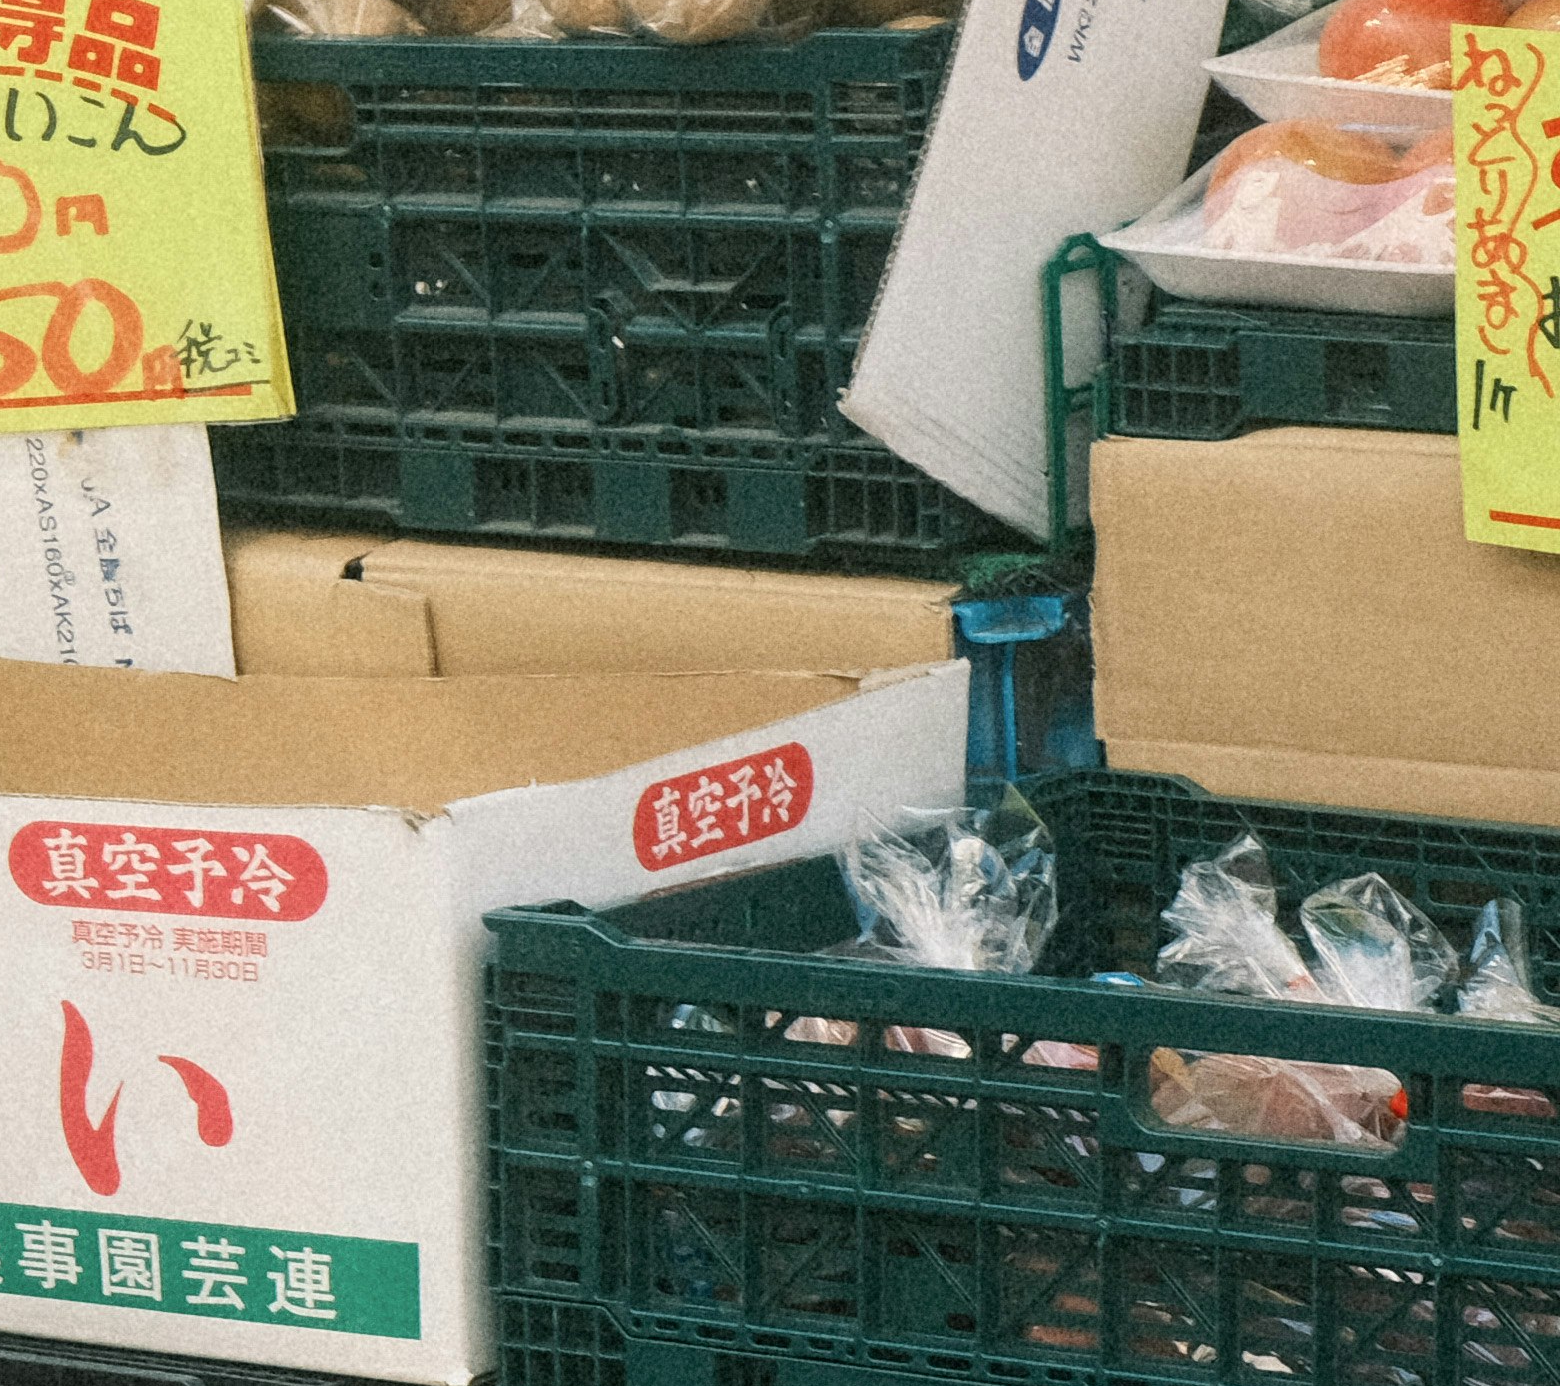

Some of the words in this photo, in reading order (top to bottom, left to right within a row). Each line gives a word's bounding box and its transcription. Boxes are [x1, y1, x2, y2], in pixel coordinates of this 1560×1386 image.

[648, 757, 808, 857] 真空予冷
[39, 829, 295, 919] 真空予冷
[68, 916, 167, 957] 真空予冷
[170, 924, 270, 963] 実施期間
